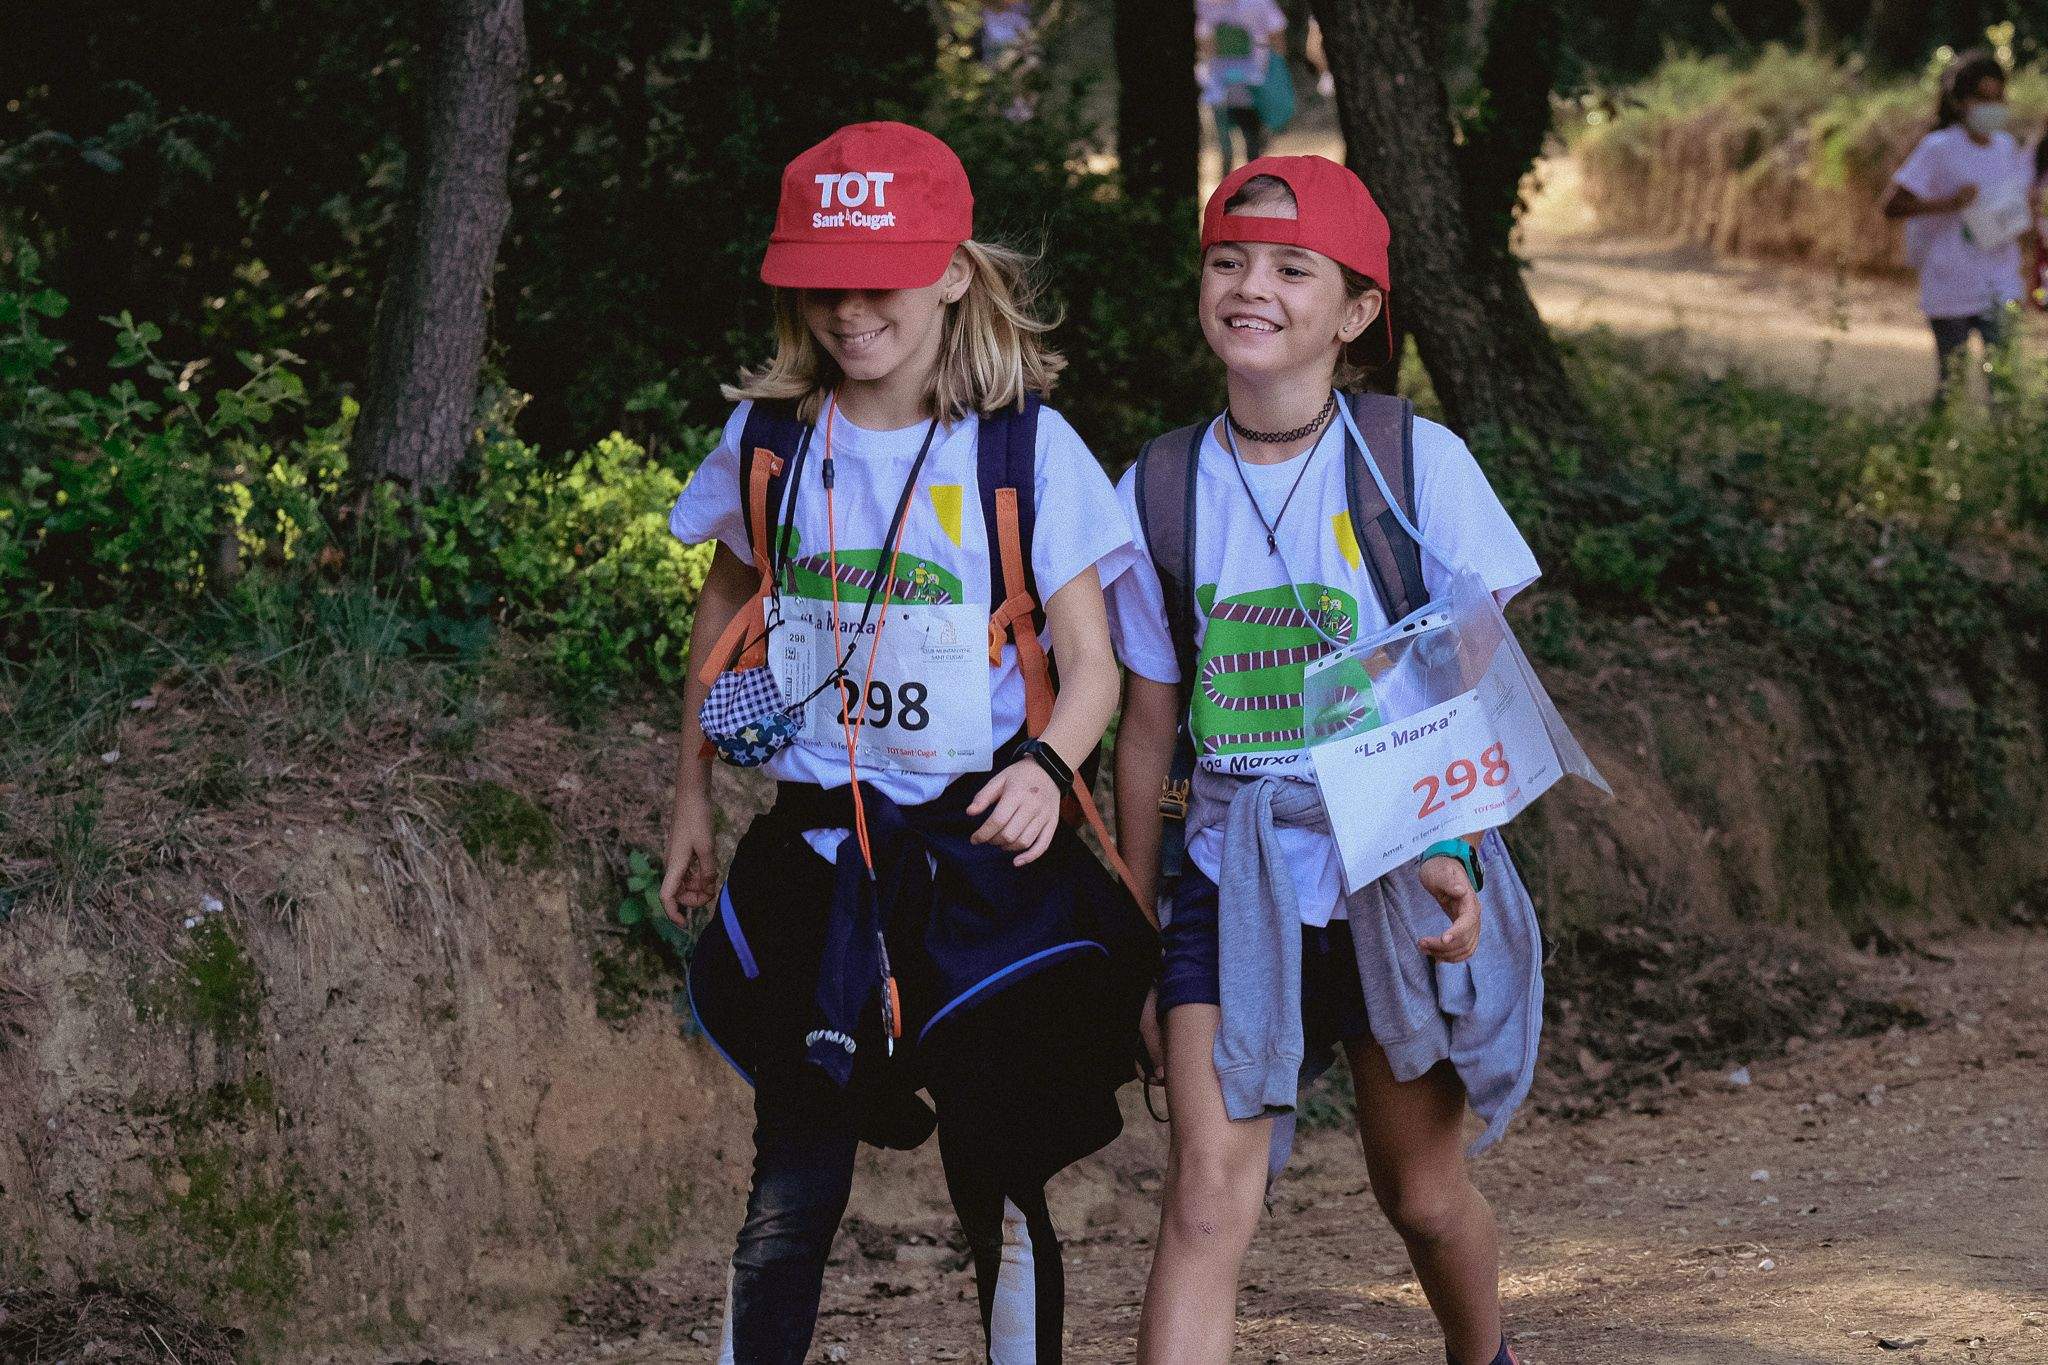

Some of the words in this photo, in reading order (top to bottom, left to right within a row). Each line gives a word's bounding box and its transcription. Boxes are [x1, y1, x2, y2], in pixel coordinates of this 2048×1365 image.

[815, 171, 894, 208] TOT
[812, 211, 846, 228] Sant
[851, 211, 896, 230] Cugat
[790, 633, 805, 643] 298
[834, 678, 930, 731] 298
[1392, 709, 1458, 749] Marxa”
[1230, 754, 1300, 773] Marxa
[1412, 741, 1511, 820] 298
